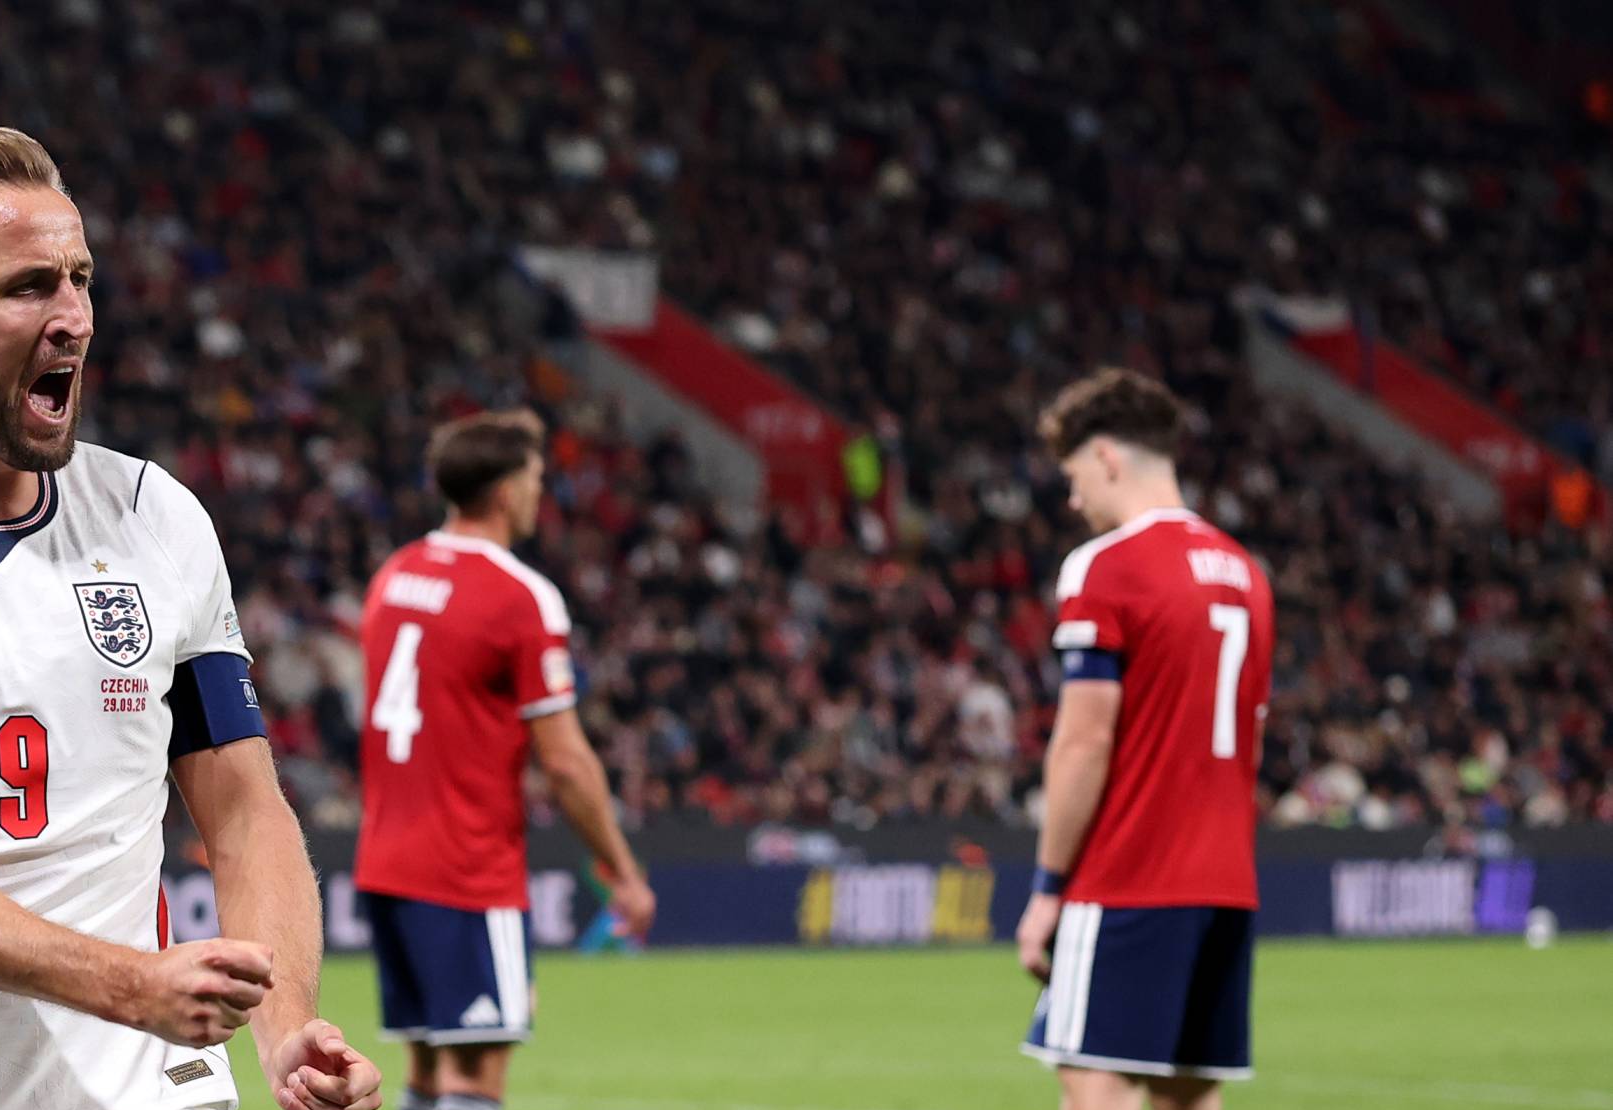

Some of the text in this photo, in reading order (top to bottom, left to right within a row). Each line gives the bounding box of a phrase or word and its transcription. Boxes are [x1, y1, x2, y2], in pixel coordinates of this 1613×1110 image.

[100, 678, 149, 693] CZECHIA
[103, 697, 146, 712] 29.09.26
[372, 622, 423, 764] 4
[1209, 603, 1249, 760] 7
